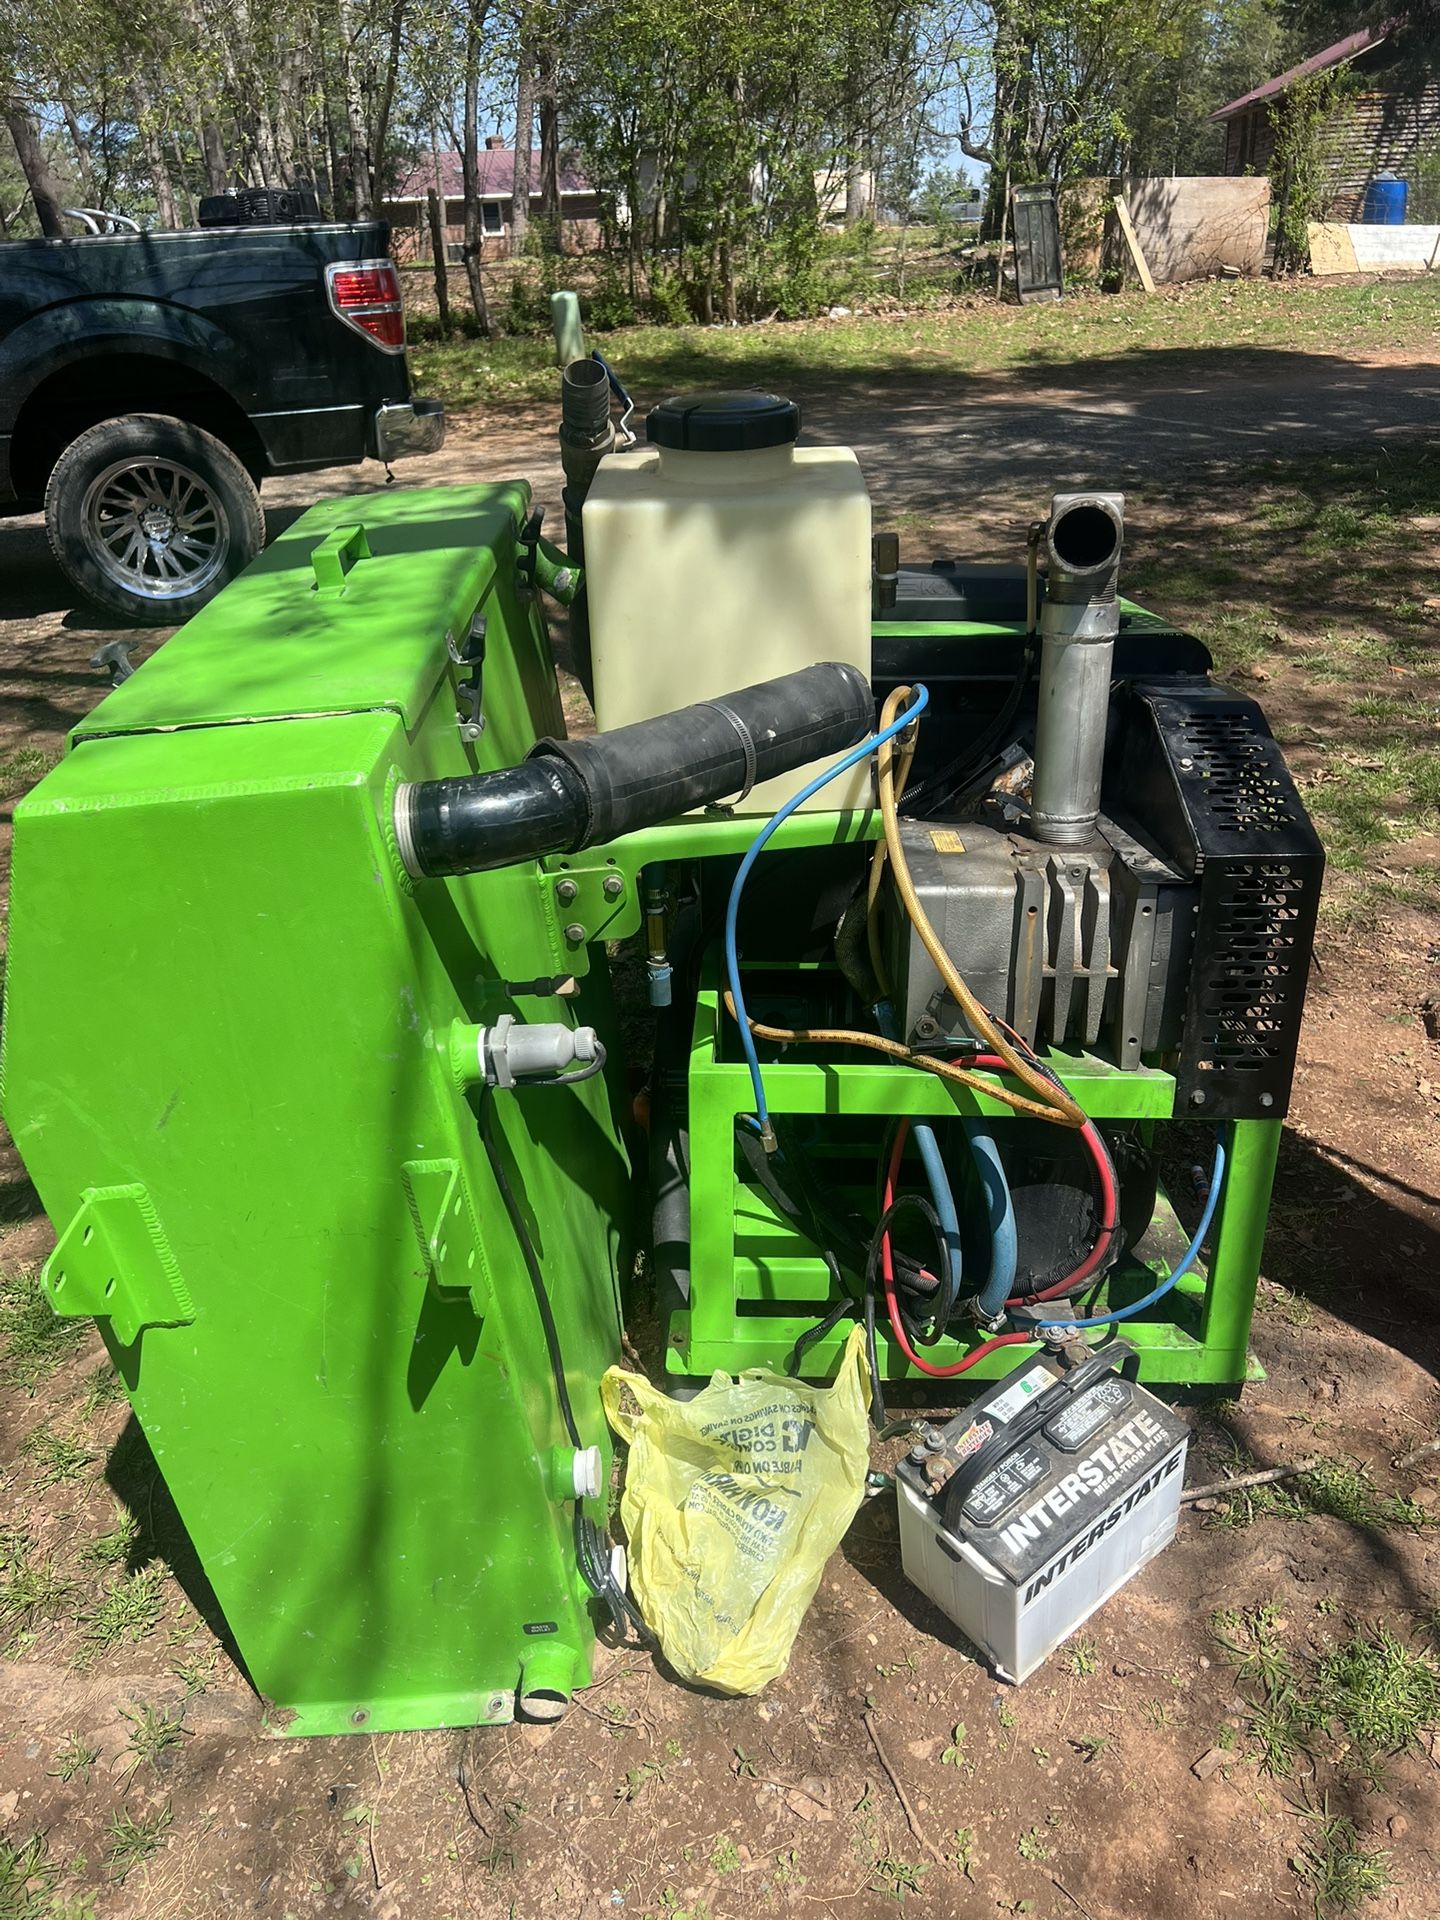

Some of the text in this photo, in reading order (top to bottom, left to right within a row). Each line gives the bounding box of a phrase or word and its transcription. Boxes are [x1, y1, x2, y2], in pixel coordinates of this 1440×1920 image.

[956, 1422, 991, 1451] INTERSTATE
[961, 1428, 994, 1456] BATTERIES
[1094, 1428, 1170, 1497] MEGA-TRON PLUS
[975, 1470, 998, 1490] DANGER
[999, 1451, 1020, 1470] POISON
[1000, 1409, 1162, 1555] INTERSTATE
[1024, 1450, 1182, 1606] INTERSTATE
